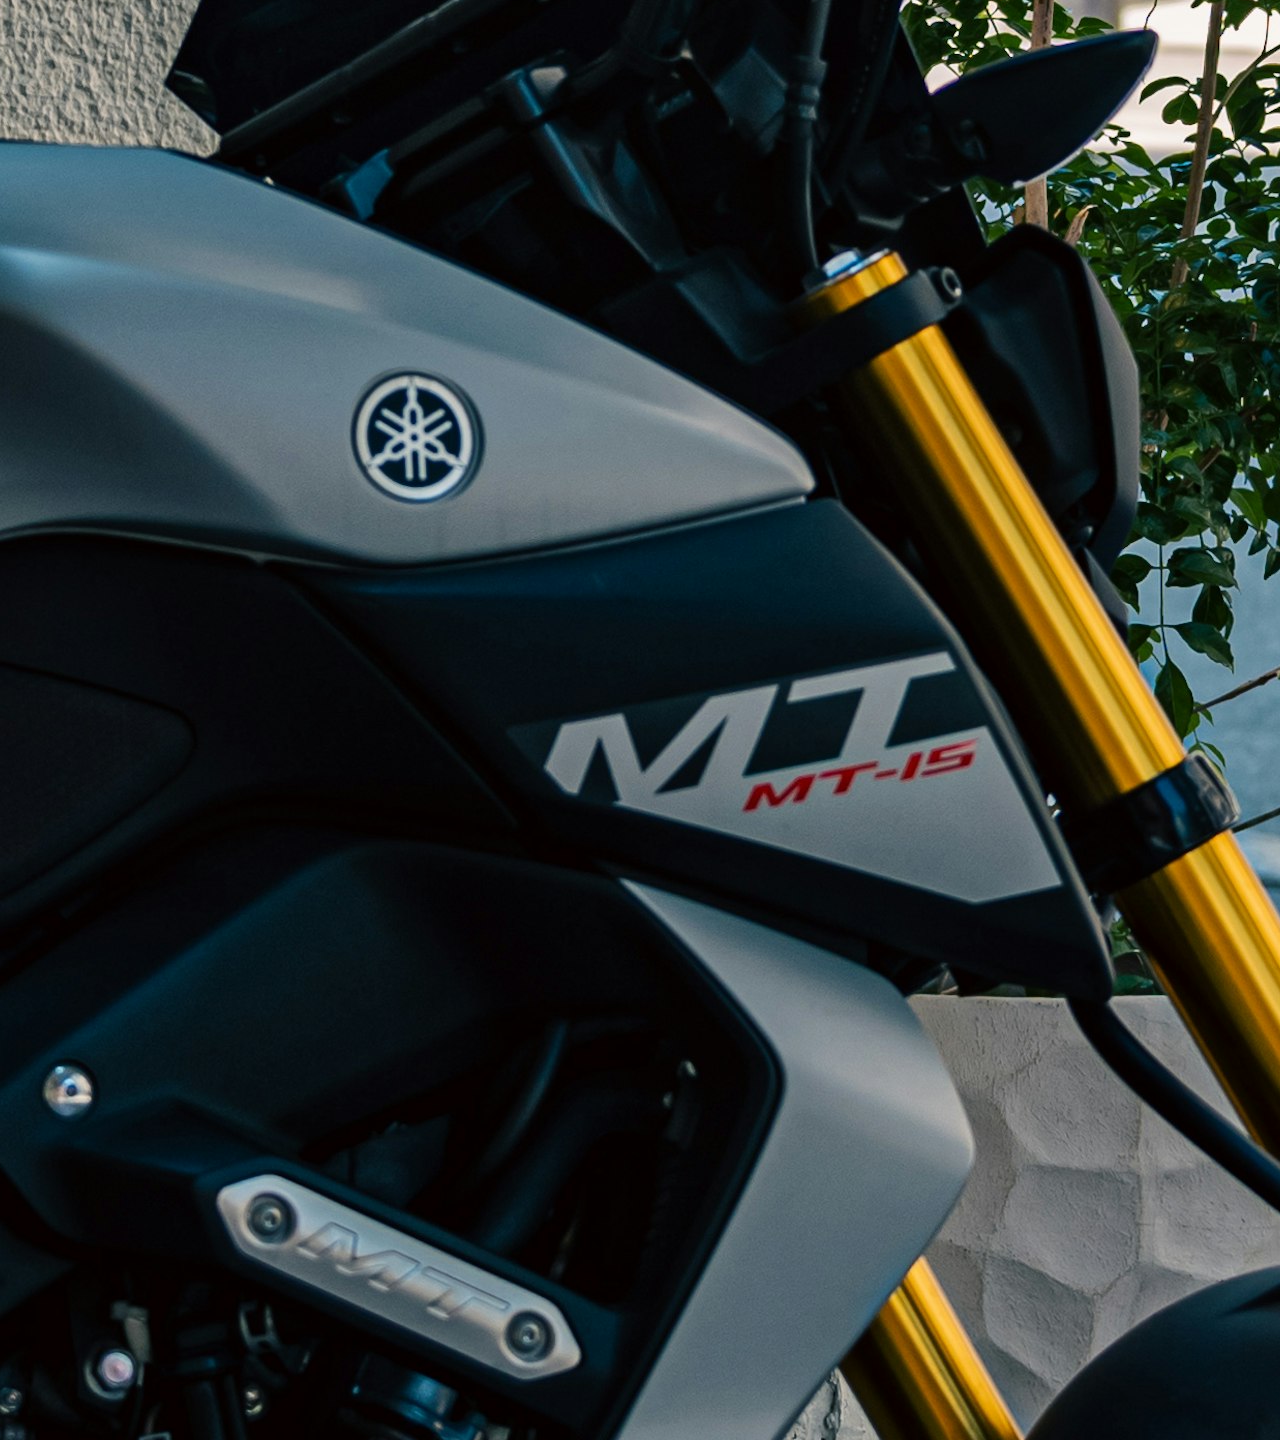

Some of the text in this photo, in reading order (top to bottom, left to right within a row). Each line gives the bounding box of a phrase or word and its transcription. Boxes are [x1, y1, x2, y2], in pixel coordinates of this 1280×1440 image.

[544, 650, 957, 804] MT
[742, 738, 979, 812] MT-15
[296, 1220, 511, 1319] MT
